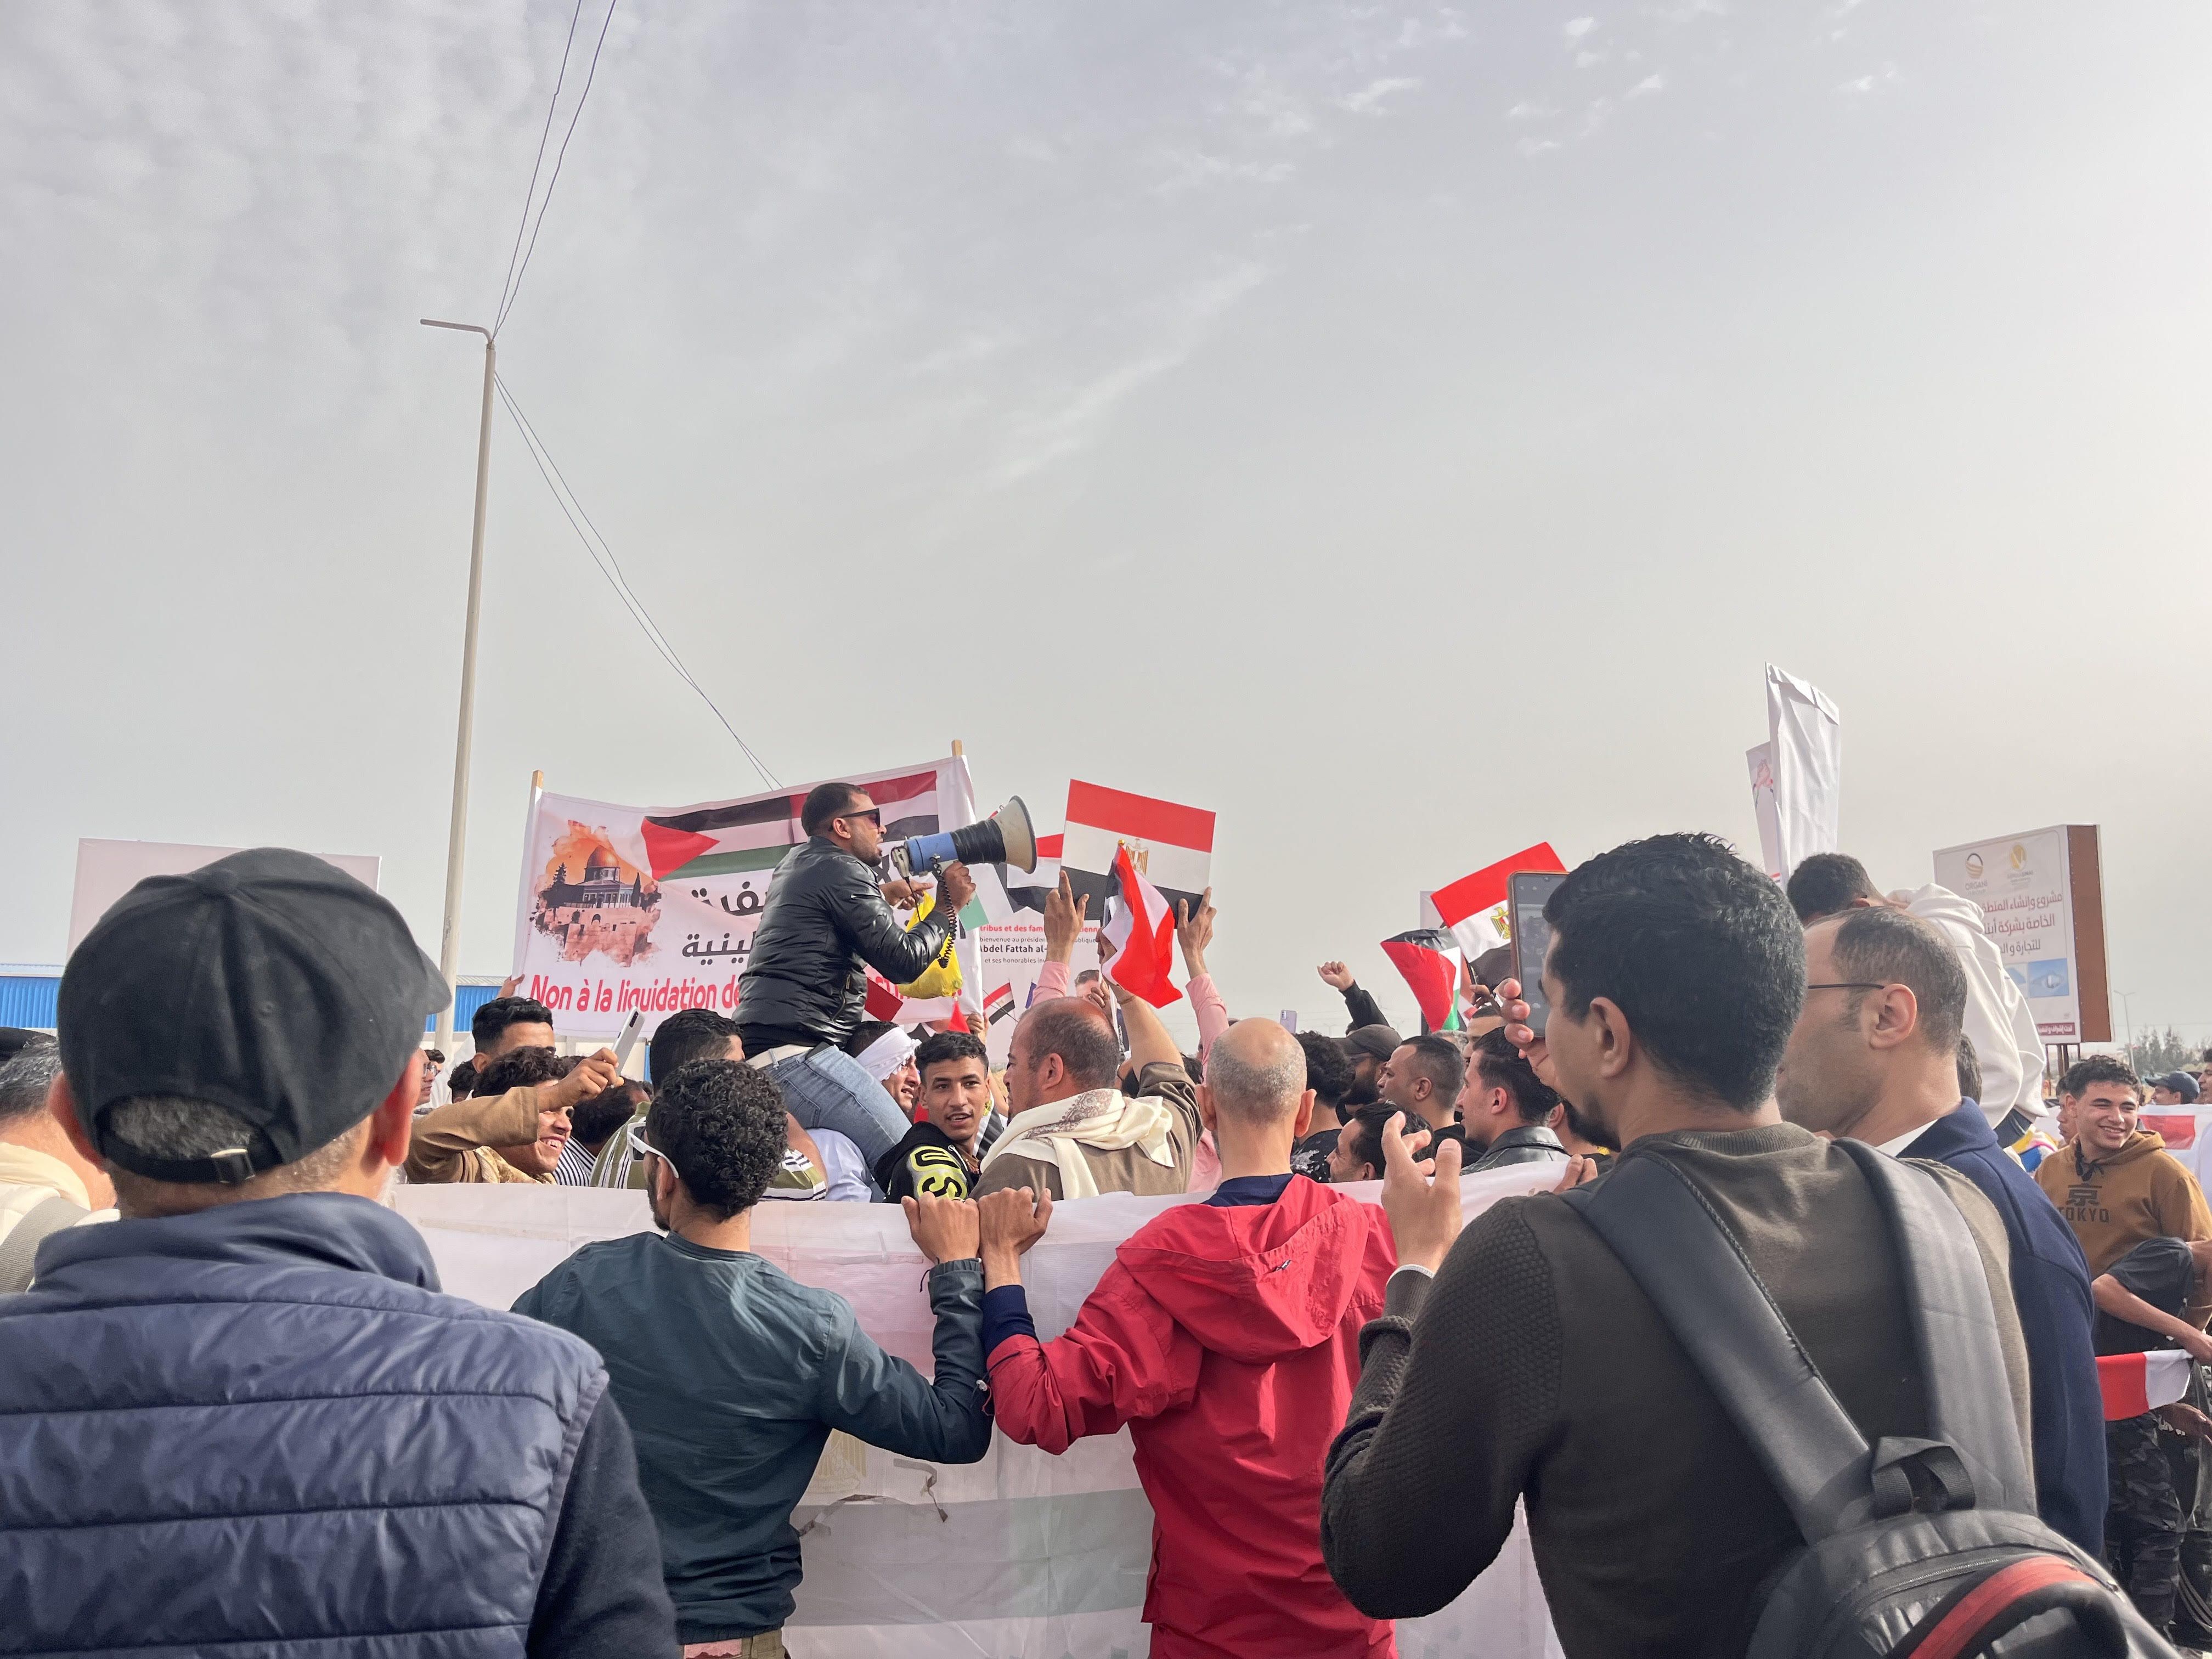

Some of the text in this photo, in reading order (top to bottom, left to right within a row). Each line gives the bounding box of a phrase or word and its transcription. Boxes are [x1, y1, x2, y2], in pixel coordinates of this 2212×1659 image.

[1982, 899, 2008, 913] المنطق
[1984, 913, 2055, 939] الخاصة بشركة أبنا
[2016, 939, 2041, 955] للتجارة
[530, 974, 572, 1010] Non
[577, 979, 590, 1012] à
[594, 979, 613, 1012] la
[617, 977, 717, 1013] liquidation
